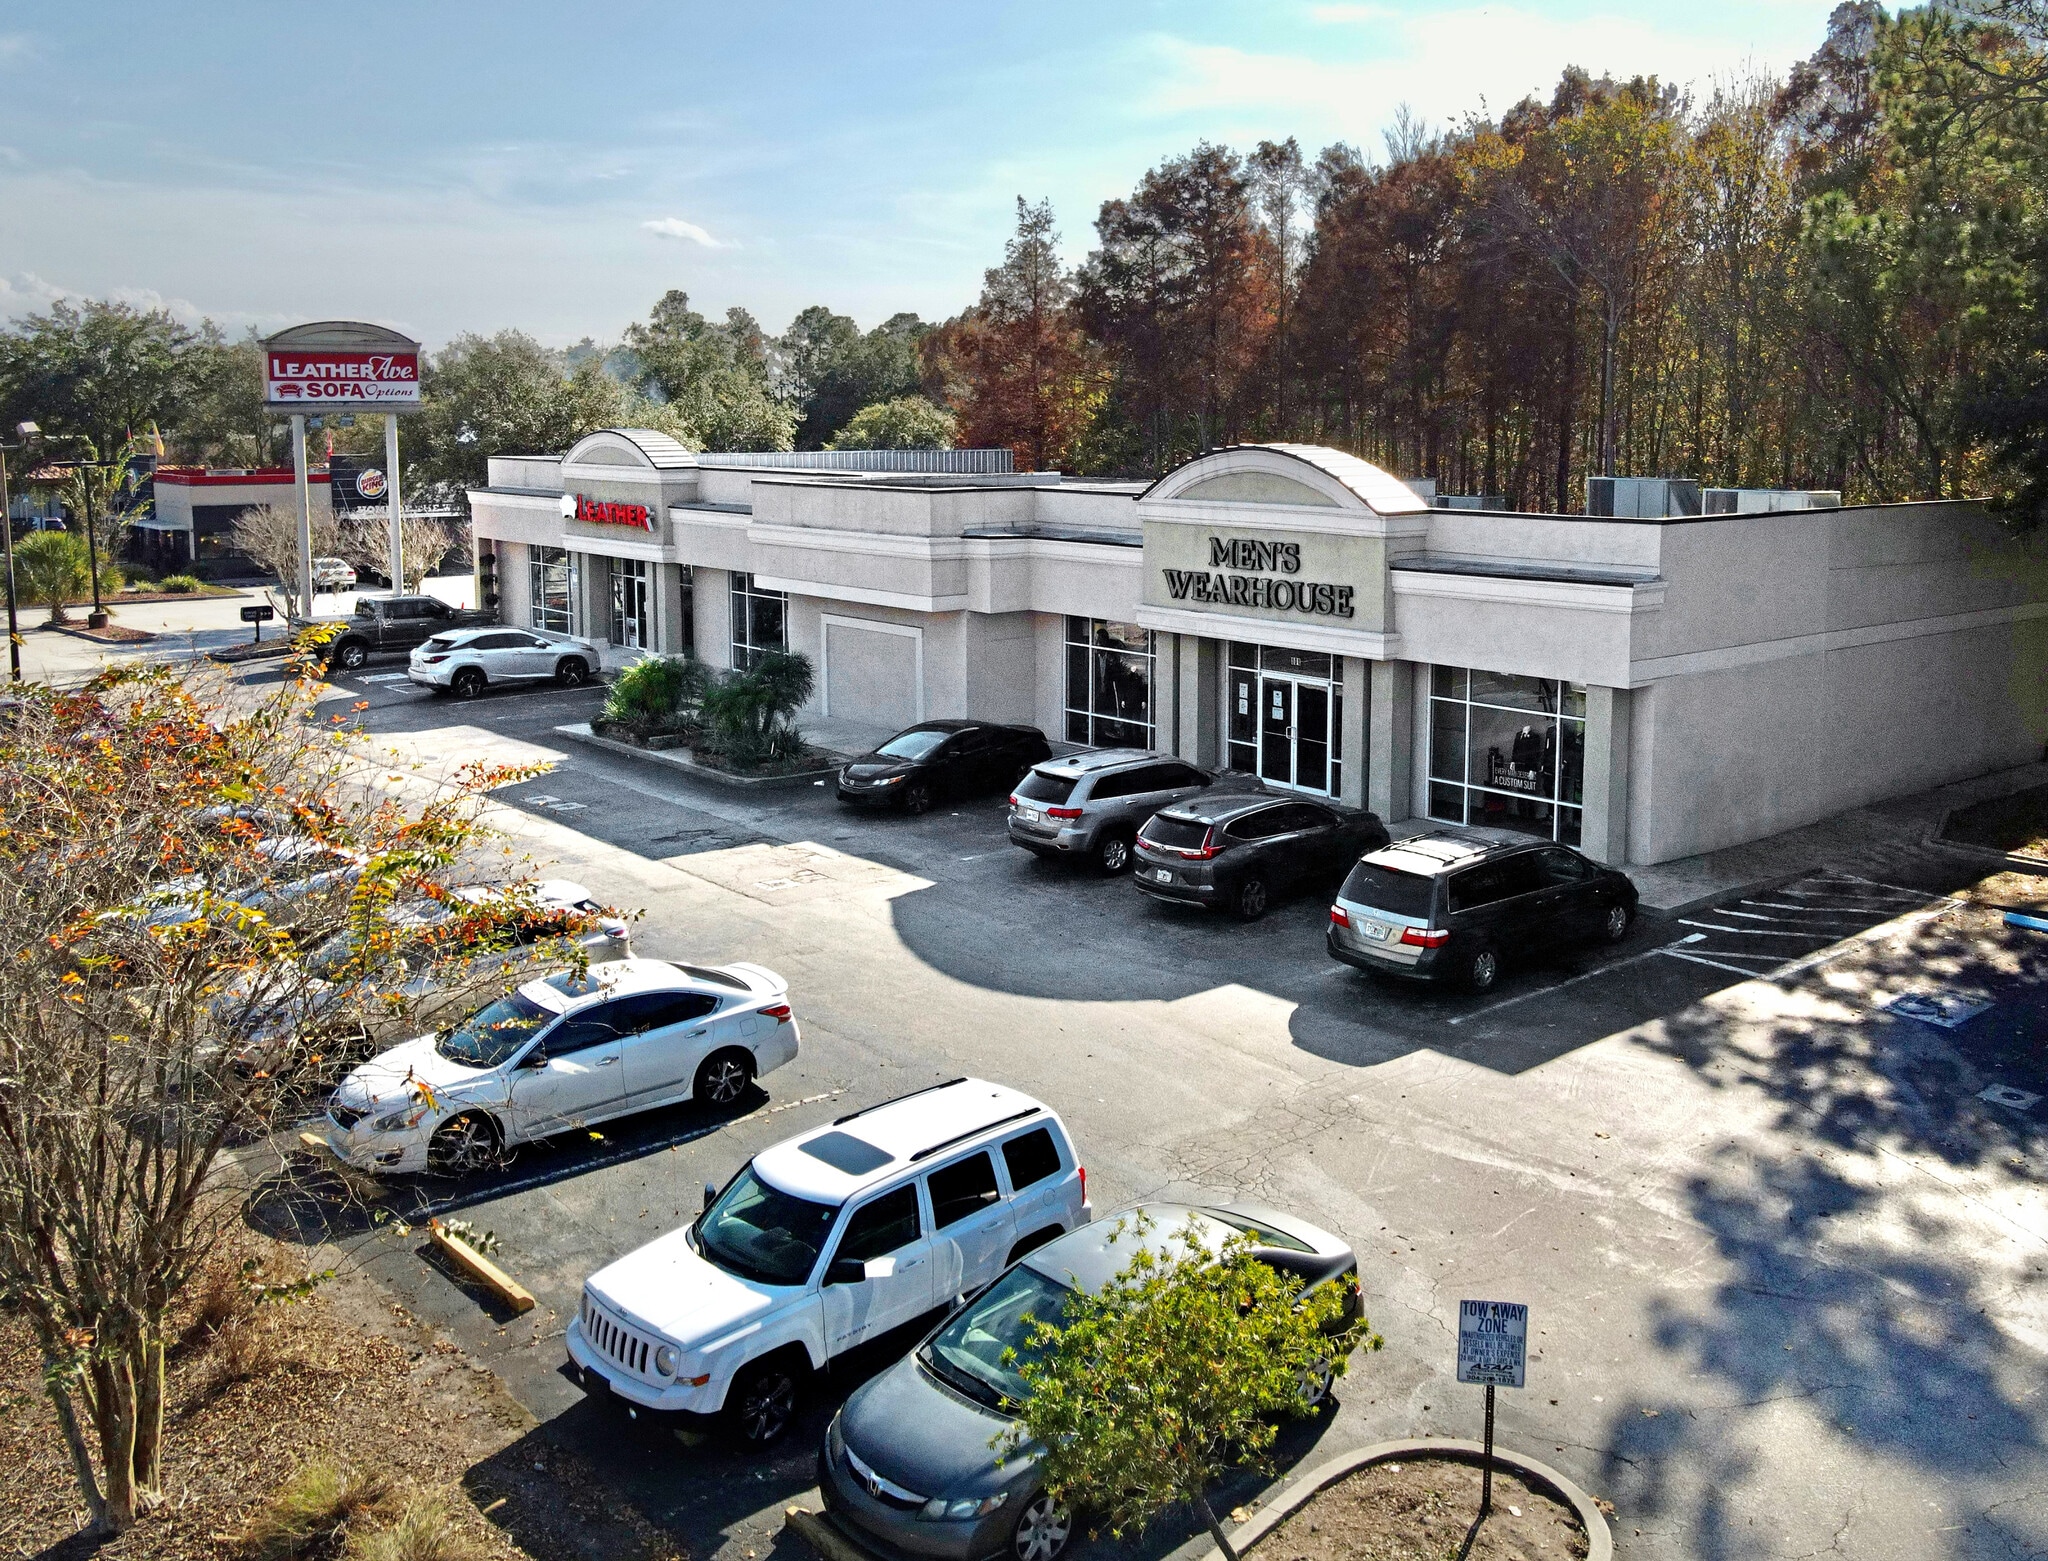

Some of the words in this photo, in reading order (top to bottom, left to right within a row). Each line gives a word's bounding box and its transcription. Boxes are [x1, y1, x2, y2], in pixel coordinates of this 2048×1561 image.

[273, 359, 374, 380] LEATHER
[307, 382, 365, 399] SOFA
[365, 383, 413, 399] Options
[362, 480, 384, 492] KING
[577, 493, 654, 532] LEATHER
[1208, 537, 1301, 574] MEN'S
[1162, 568, 1355, 618] WEARHOUSE
[1499, 776, 1523, 788] CUSTOM
[1523, 780, 1537, 791] SUIT
[1463, 1302, 1488, 1318] TOW
[1493, 1305, 1525, 1321] AWAY
[1477, 1317, 1507, 1333] ZONE
